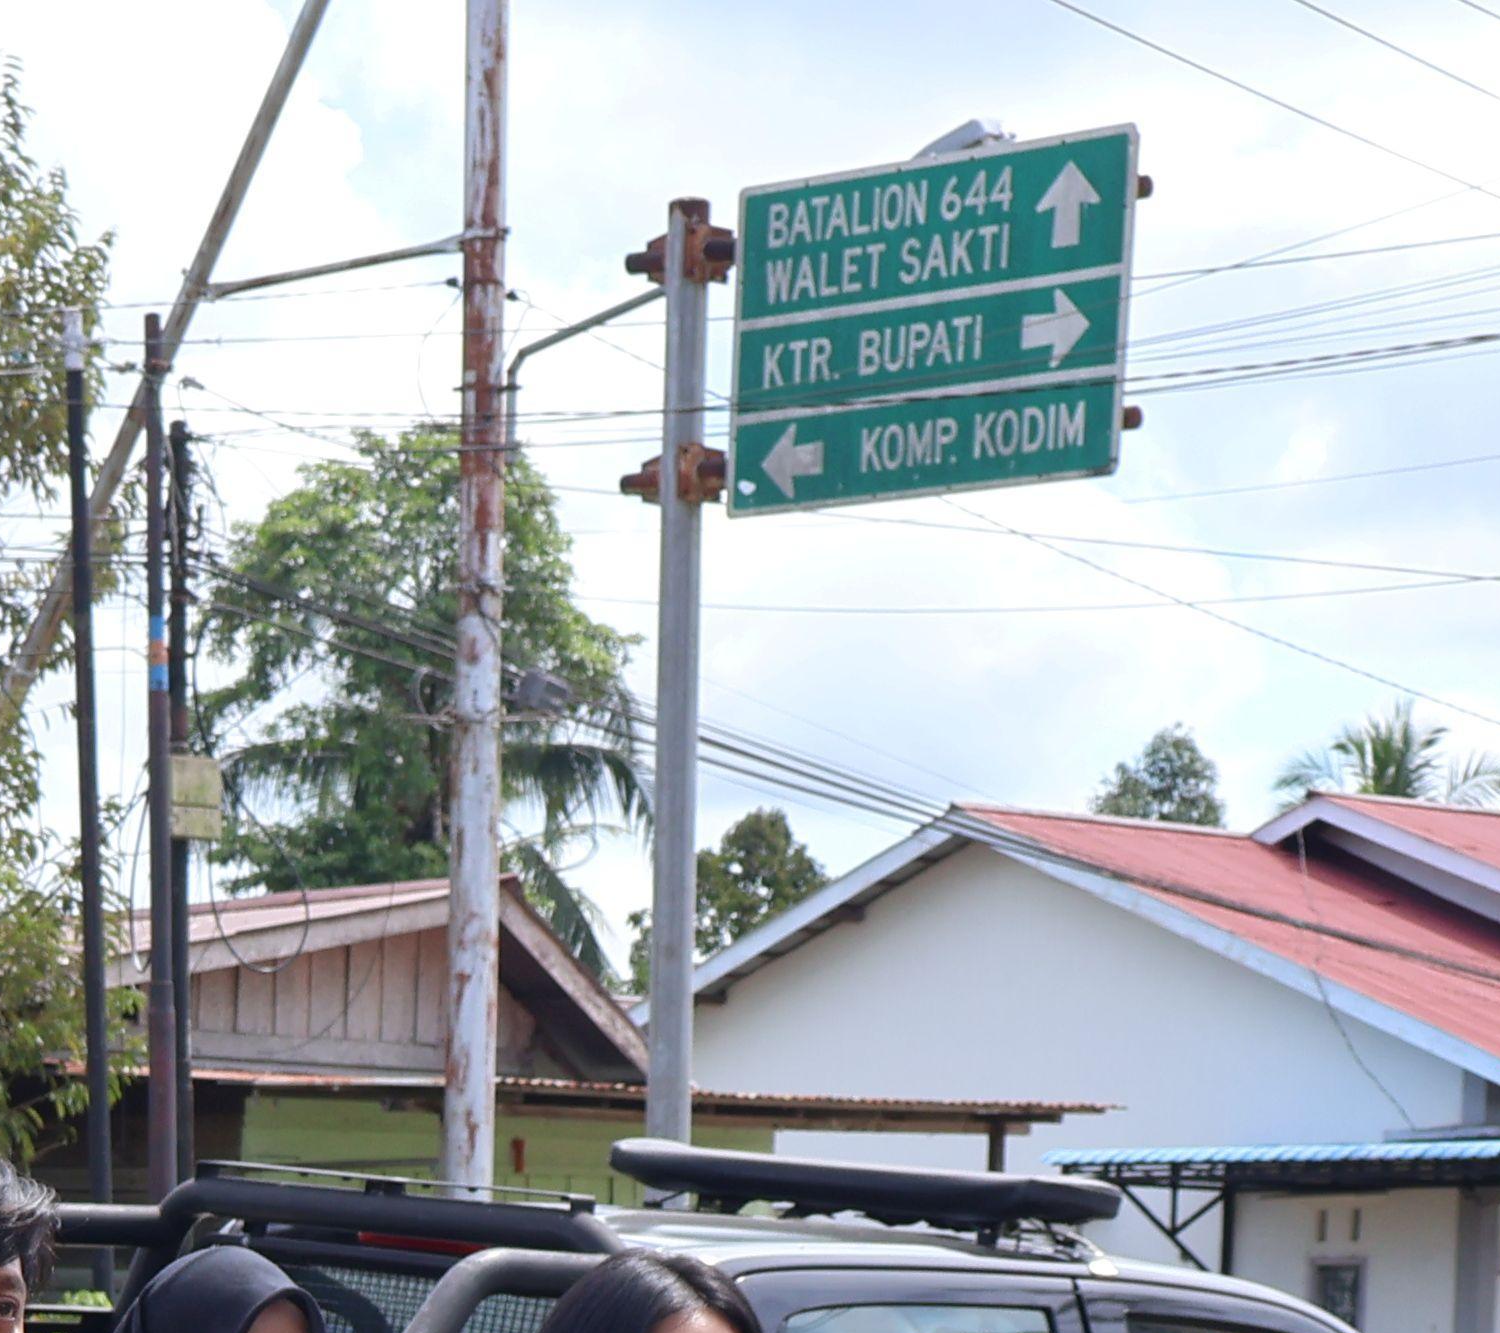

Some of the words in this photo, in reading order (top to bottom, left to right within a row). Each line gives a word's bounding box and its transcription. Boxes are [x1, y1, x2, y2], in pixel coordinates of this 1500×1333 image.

[767, 179, 928, 249] BATALION
[940, 165, 1014, 221] 644
[766, 243, 887, 305] WALET
[899, 223, 1011, 285] SAKTI
[762, 337, 841, 390] KTR.
[857, 314, 983, 377] BUPATI
[859, 418, 958, 474] KOMP.
[973, 400, 1086, 461] KODIM
